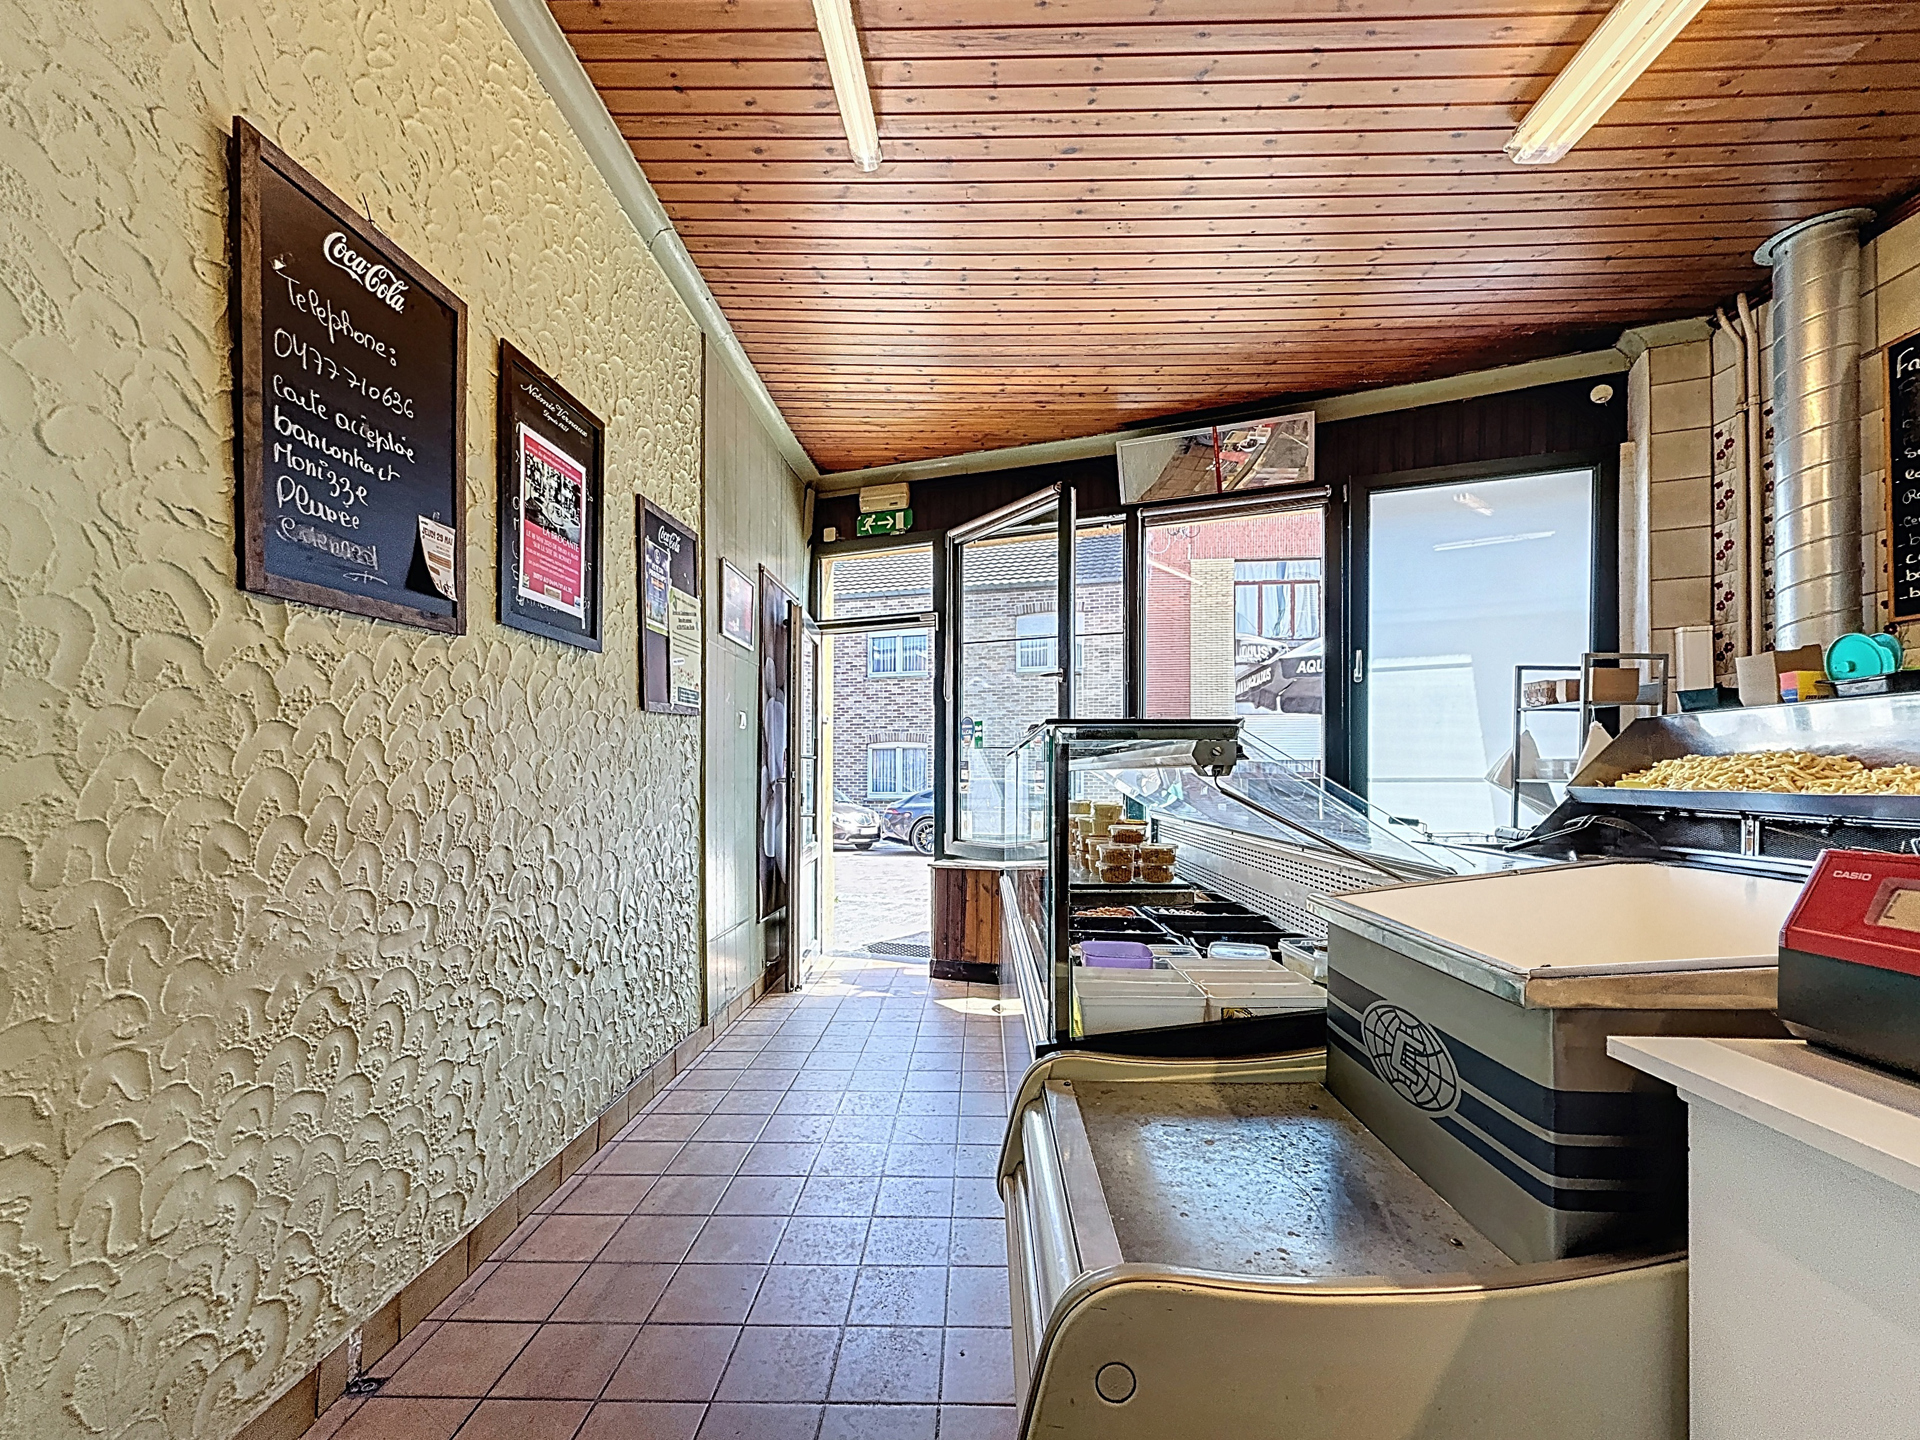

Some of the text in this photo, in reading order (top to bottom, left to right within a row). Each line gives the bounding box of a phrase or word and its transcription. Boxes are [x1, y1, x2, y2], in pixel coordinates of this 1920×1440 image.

[323, 231, 409, 314] Coca-Cola
[274, 327, 340, 380] 0477
[1832, 869, 1872, 882] CASIO
